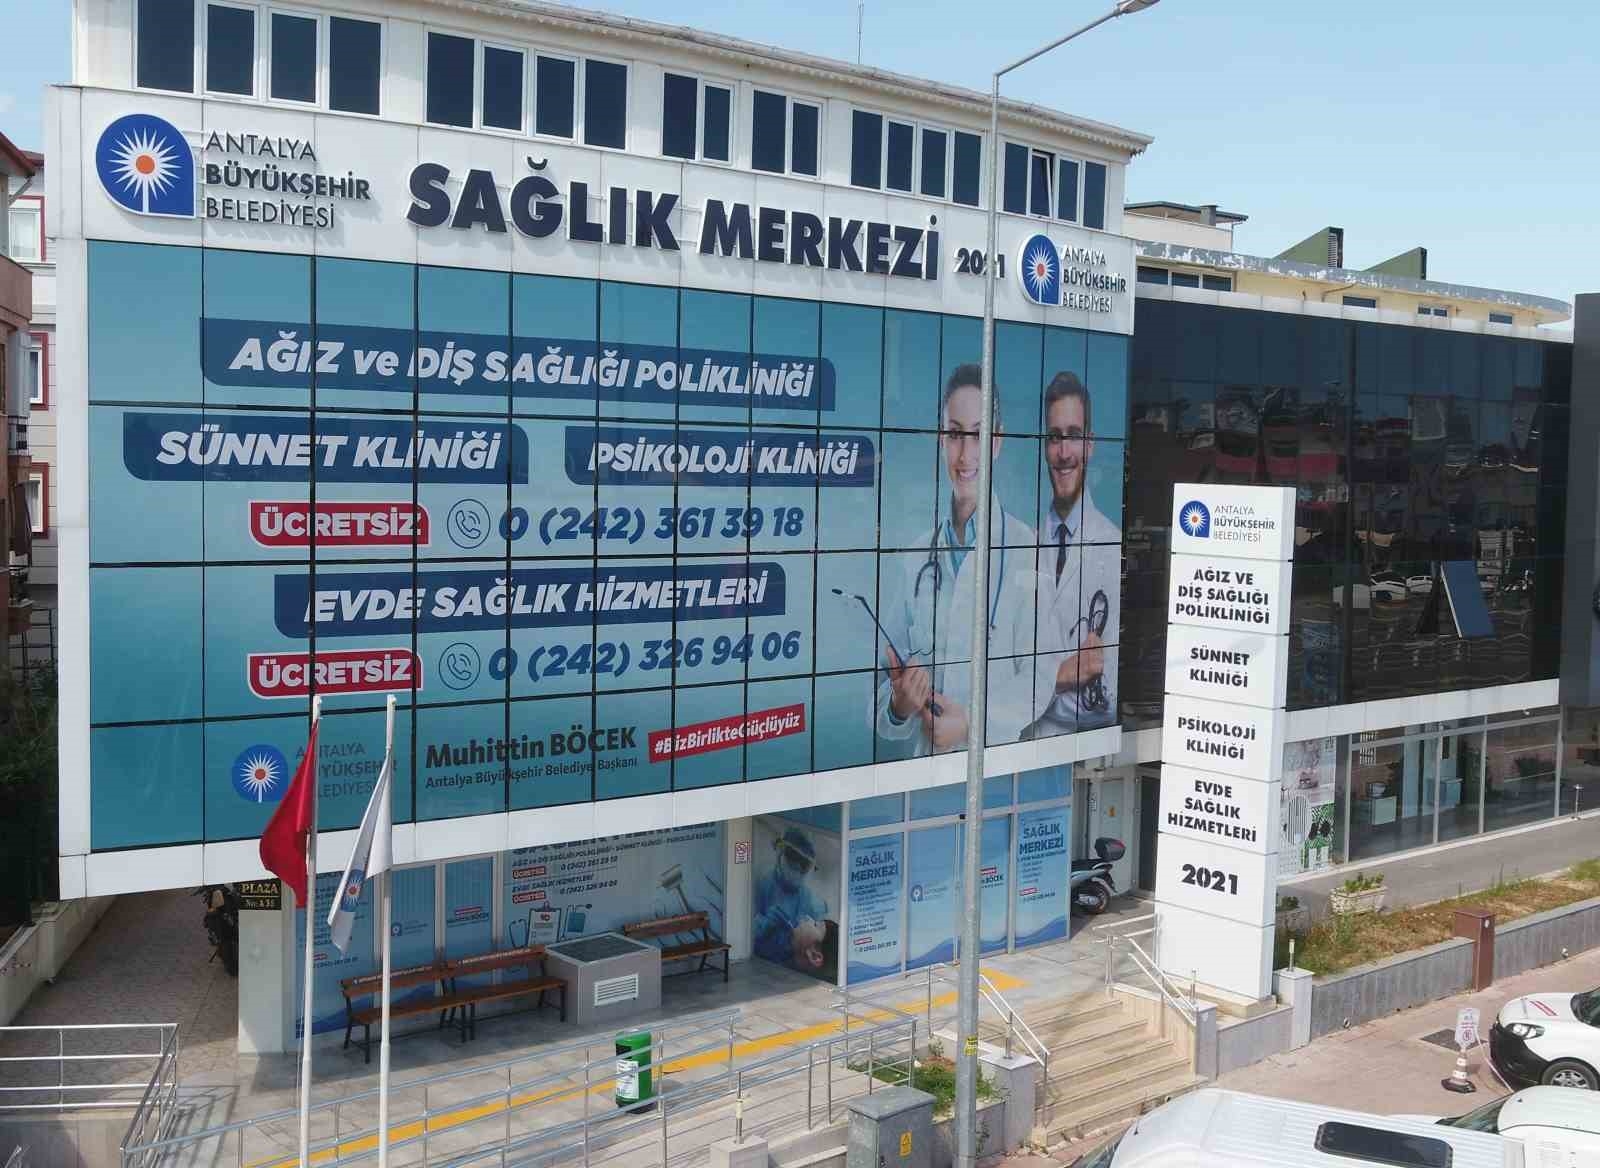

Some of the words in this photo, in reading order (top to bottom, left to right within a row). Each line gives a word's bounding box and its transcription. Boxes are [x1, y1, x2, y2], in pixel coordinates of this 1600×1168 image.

[206, 131, 317, 162] ANTALYA
[205, 160, 371, 201] BÜYÜKŞEHİR
[205, 198, 335, 228] BELEDİYESİ
[406, 155, 680, 251] SAĞLIK
[698, 198, 939, 281] MERKEZİ
[955, 247, 1006, 279] 201
[1064, 248, 1106, 265] ANTALYA
[229, 330, 345, 374] AĞIZ
[352, 349, 399, 377] ve
[407, 341, 477, 386] DİŞ
[482, 346, 630, 388] SAĞLIĞI
[634, 357, 815, 398] POLİKLİNİĞİ
[156, 424, 348, 468] SÜNNET
[352, 431, 502, 471] KLİNİĞİ
[588, 437, 754, 474] PSİKOLOJİ
[757, 442, 860, 475] KLİNİĞİ
[260, 506, 421, 537] ÜCRETSİZ
[1214, 504, 1255, 516] ANTALYA
[499, 507, 529, 541] 0
[539, 507, 646, 546] (242)
[654, 507, 716, 539] 361
[720, 507, 764, 538] 39
[773, 507, 805, 537] 18
[1194, 566, 1230, 583] AĞIZ
[1235, 572, 1254, 586] VE
[304, 588, 426, 622] EVDE
[431, 577, 572, 618] SAĞLIK
[574, 570, 769, 612] HİZMETLERİ
[1178, 582, 1203, 604] DİŞ
[1207, 586, 1269, 606] SAĞLIĞI
[1175, 603, 1270, 625] POLİKLİNİĞİ
[488, 647, 518, 680] 0
[528, 641, 631, 682] (242)
[638, 637, 705, 670] 326
[711, 634, 755, 666] 94
[761, 630, 802, 661] 06
[1190, 645, 1250, 666] SÜNNET
[258, 654, 413, 688] ÜCRETSİZ
[1190, 667, 1248, 688] KLİNİĞİ
[1178, 715, 1256, 741] PSİKOLOJİ
[297, 742, 365, 760] ATALYA
[425, 734, 545, 768] Muhittin
[550, 724, 637, 756] BÖCEK
[1186, 738, 1245, 760] KLİNİĞİ
[425, 774, 473, 789] Antalya
[597, 757, 638, 772] Başkanı
[1194, 780, 1232, 798] EVDE
[1184, 797, 1241, 819] SAĞLIK
[1022, 823, 1061, 839] SAĞLIK
[1168, 811, 1257, 842] HİZMETLERİ
[855, 850, 895, 867] SAĞLIK
[1019, 833, 1065, 854] MERKEZİ
[851, 861, 899, 882] MERKEZİ
[1181, 863, 1239, 895] 2021
